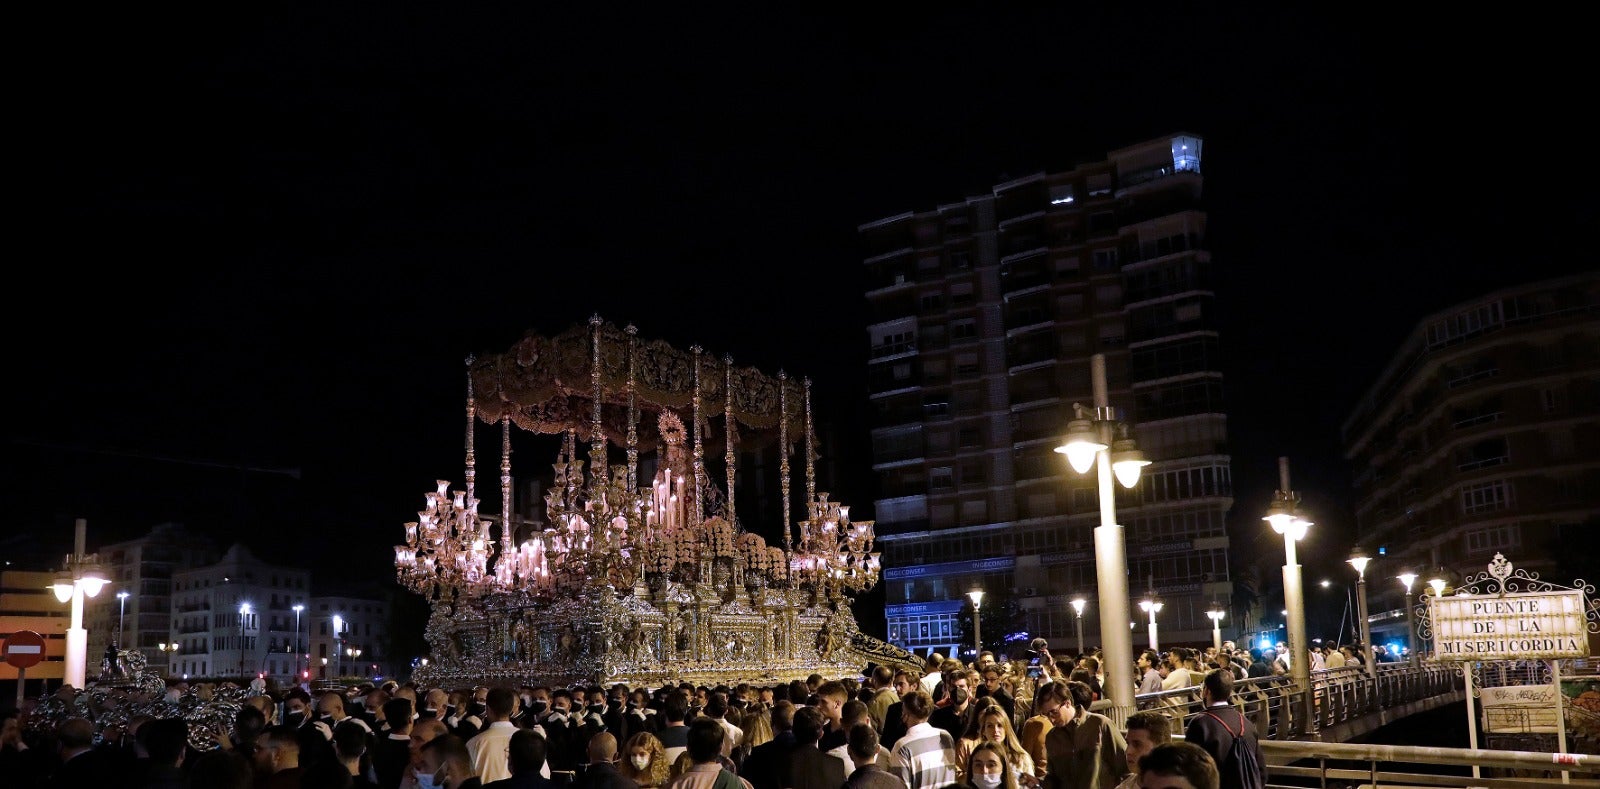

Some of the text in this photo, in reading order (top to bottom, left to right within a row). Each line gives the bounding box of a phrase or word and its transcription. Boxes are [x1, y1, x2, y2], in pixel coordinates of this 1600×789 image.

[972, 559, 1014, 569] INGECONSER
[887, 568, 926, 577] INGECONSER
[888, 605, 928, 614] INGECONSER
[1472, 600, 1539, 615] PUENTE
[1473, 620, 1541, 634] DE LA
[1443, 639, 1578, 654] MISERICORDIA
